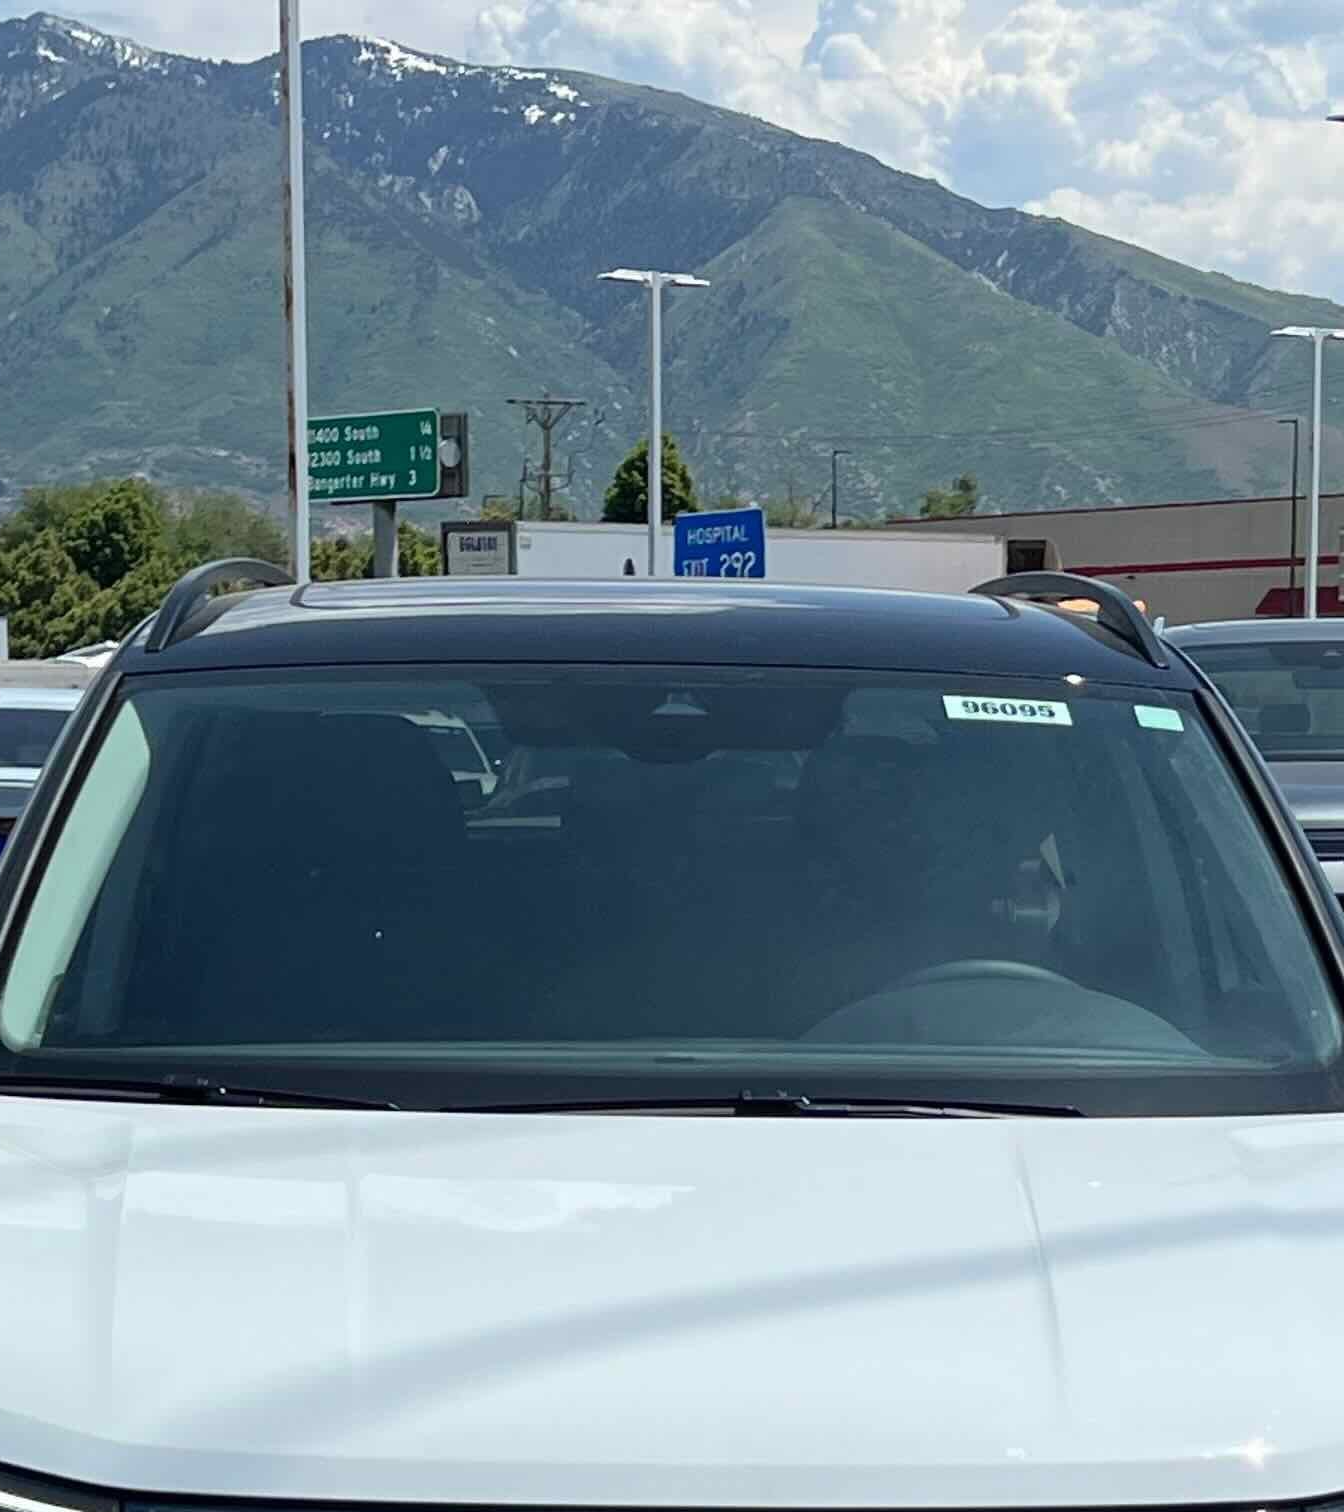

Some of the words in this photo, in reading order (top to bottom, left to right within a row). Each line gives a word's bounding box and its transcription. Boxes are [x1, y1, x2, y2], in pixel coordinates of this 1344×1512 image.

[344, 425, 379, 441] South
[308, 450, 341, 468] 2300
[347, 448, 381, 465] South
[370, 472, 396, 489] Hwy
[409, 470, 417, 486] 3
[687, 525, 750, 545] HOSPITAL
[719, 551, 756, 577] 292
[961, 700, 1056, 718] 96095
